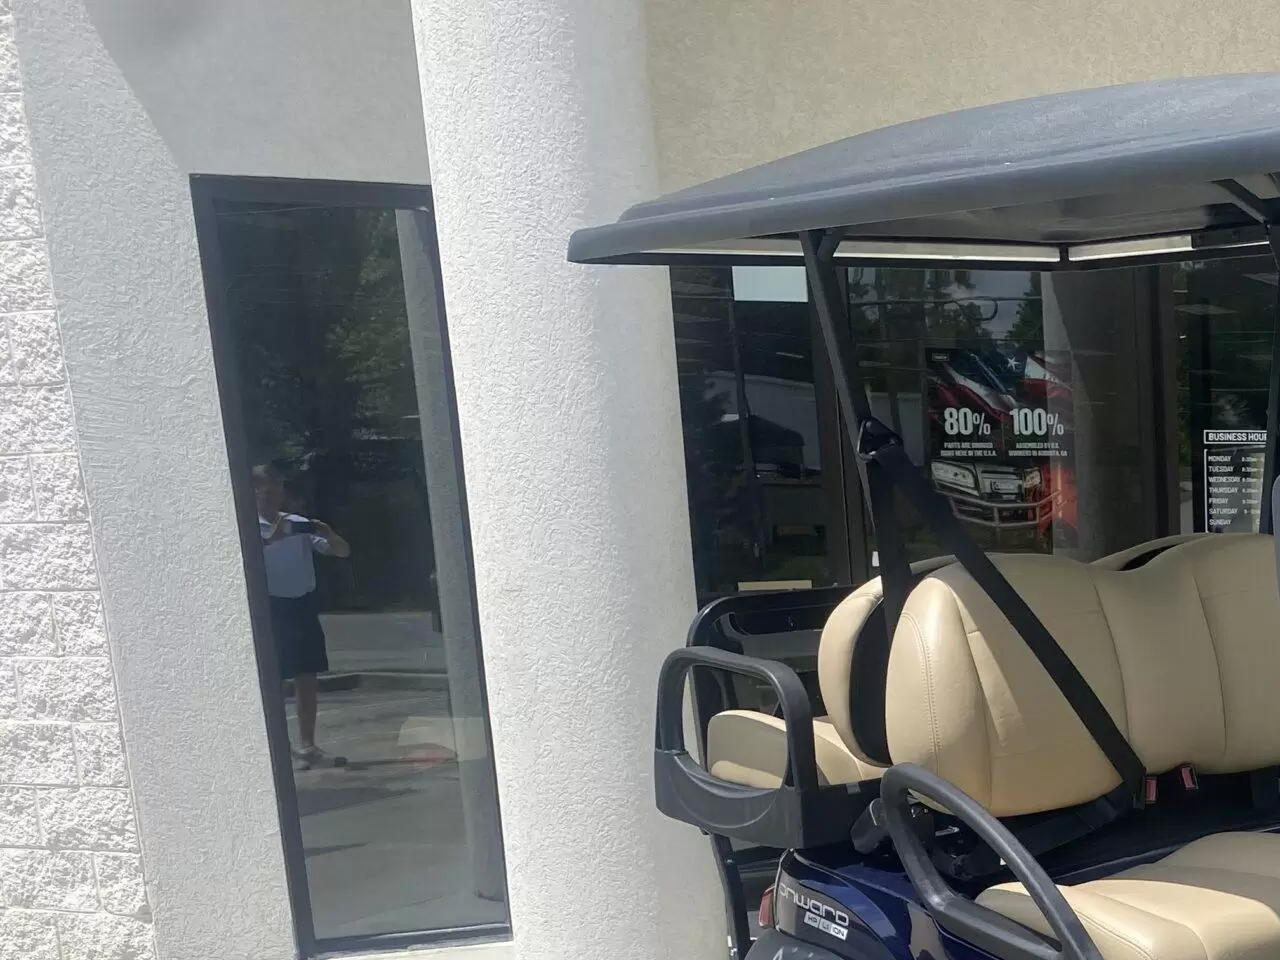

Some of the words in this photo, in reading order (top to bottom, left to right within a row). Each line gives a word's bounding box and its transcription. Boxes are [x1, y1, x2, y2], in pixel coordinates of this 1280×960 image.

[943, 407, 991, 436] 80%
[1009, 407, 1064, 436] 100%
[1208, 432, 1247, 441] BUSINESS
